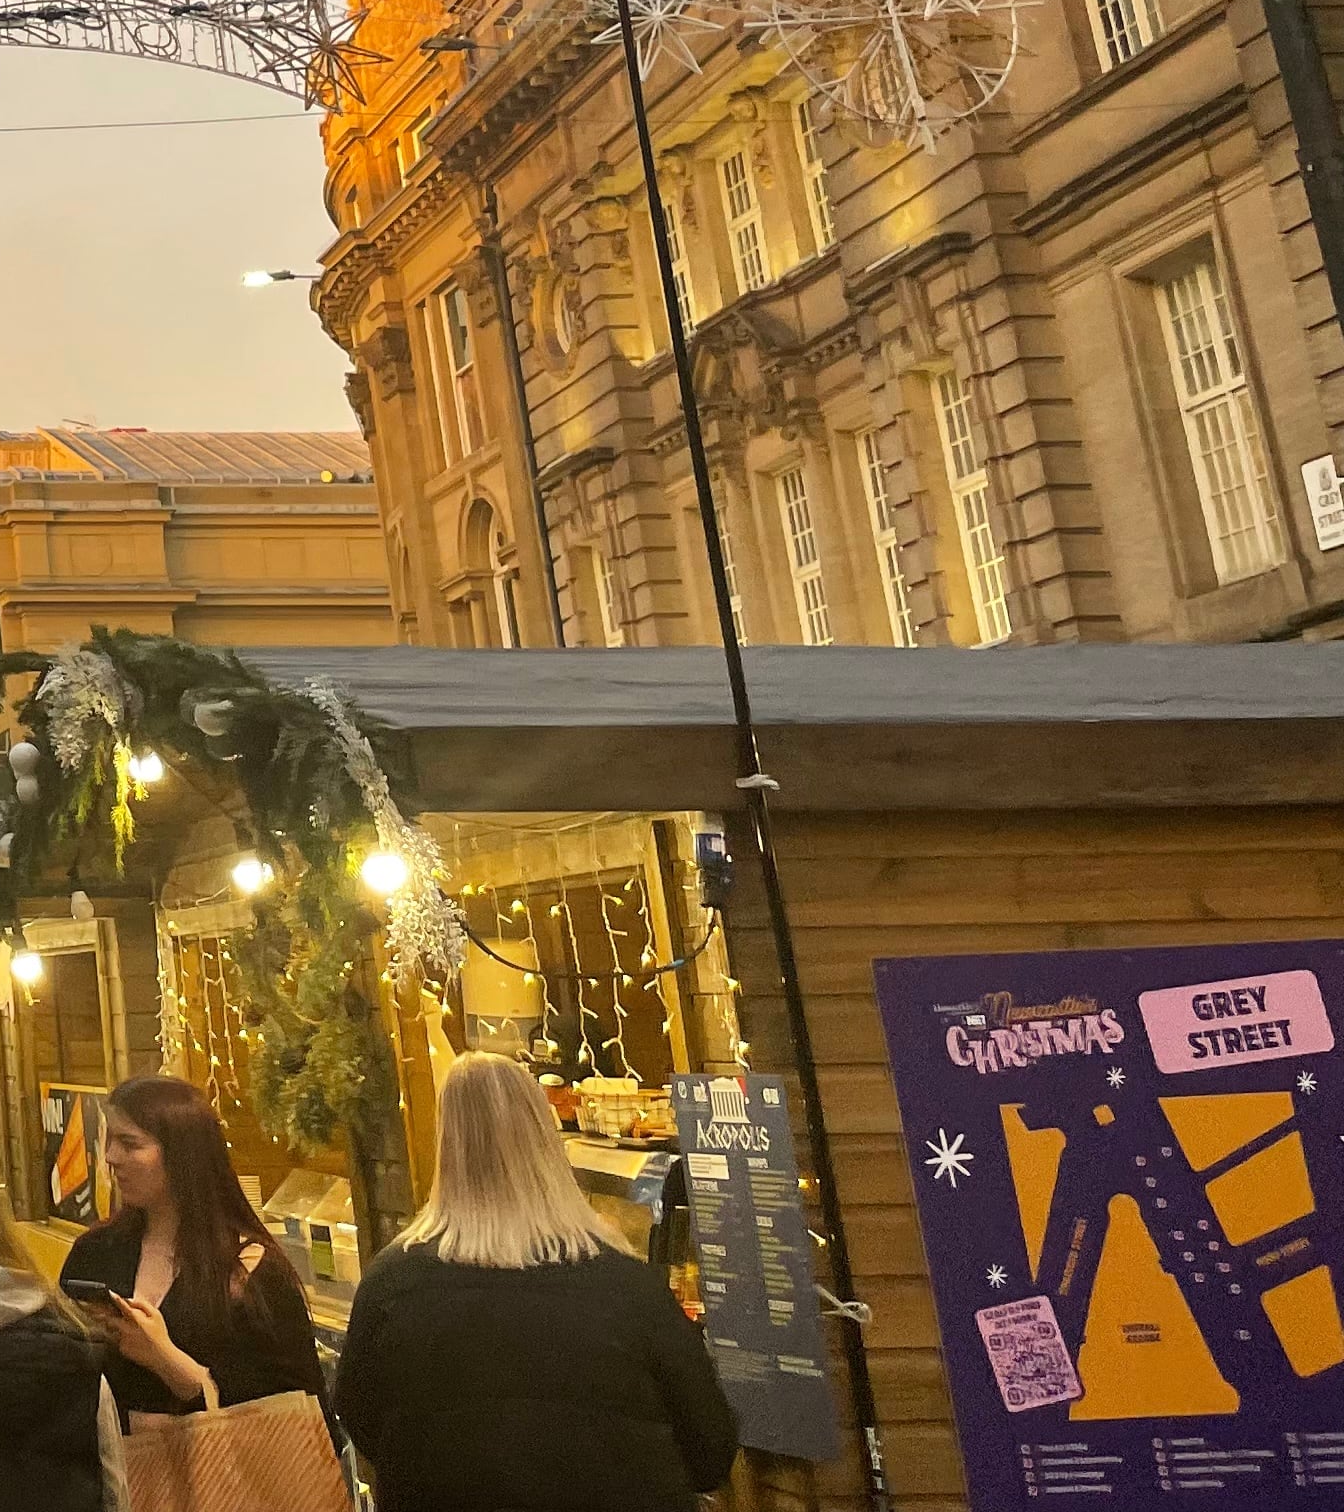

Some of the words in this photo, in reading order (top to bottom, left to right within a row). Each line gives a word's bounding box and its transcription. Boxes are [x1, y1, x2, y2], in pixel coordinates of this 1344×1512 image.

[1191, 986, 1268, 1021] GREY
[945, 1009, 1124, 1074] CHRISTMAS
[1187, 1019, 1291, 1059] STREET
